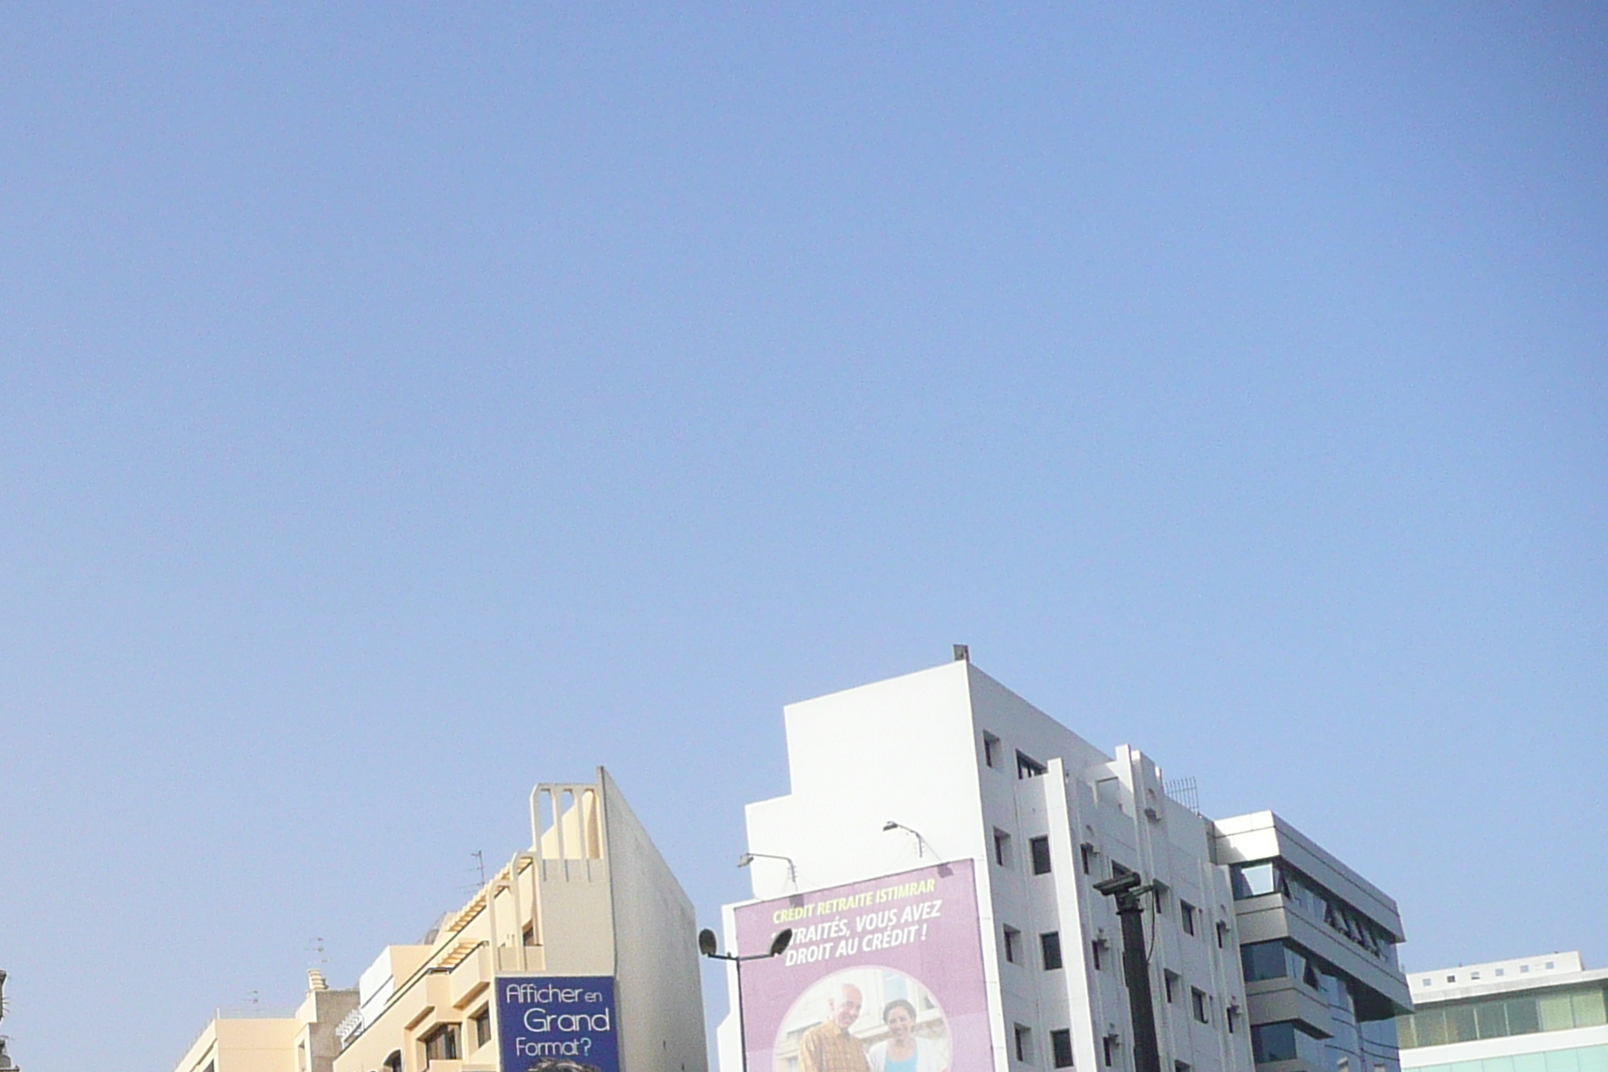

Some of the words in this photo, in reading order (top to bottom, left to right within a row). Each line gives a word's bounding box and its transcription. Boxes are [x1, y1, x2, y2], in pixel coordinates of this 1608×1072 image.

[817, 891, 873, 915] RETRAITE
[876, 878, 935, 903] ISTIMRAR
[770, 915, 851, 946] TRAITÉS,
[856, 908, 898, 932] VOUS
[900, 899, 942, 924] AVEZ
[785, 942, 834, 967] DROIT
[835, 938, 859, 957] AU
[862, 925, 919, 952] CRÉDIT
[506, 983, 583, 1004] Afficher
[584, 992, 603, 1002] en
[523, 1007, 611, 1033] Grand
